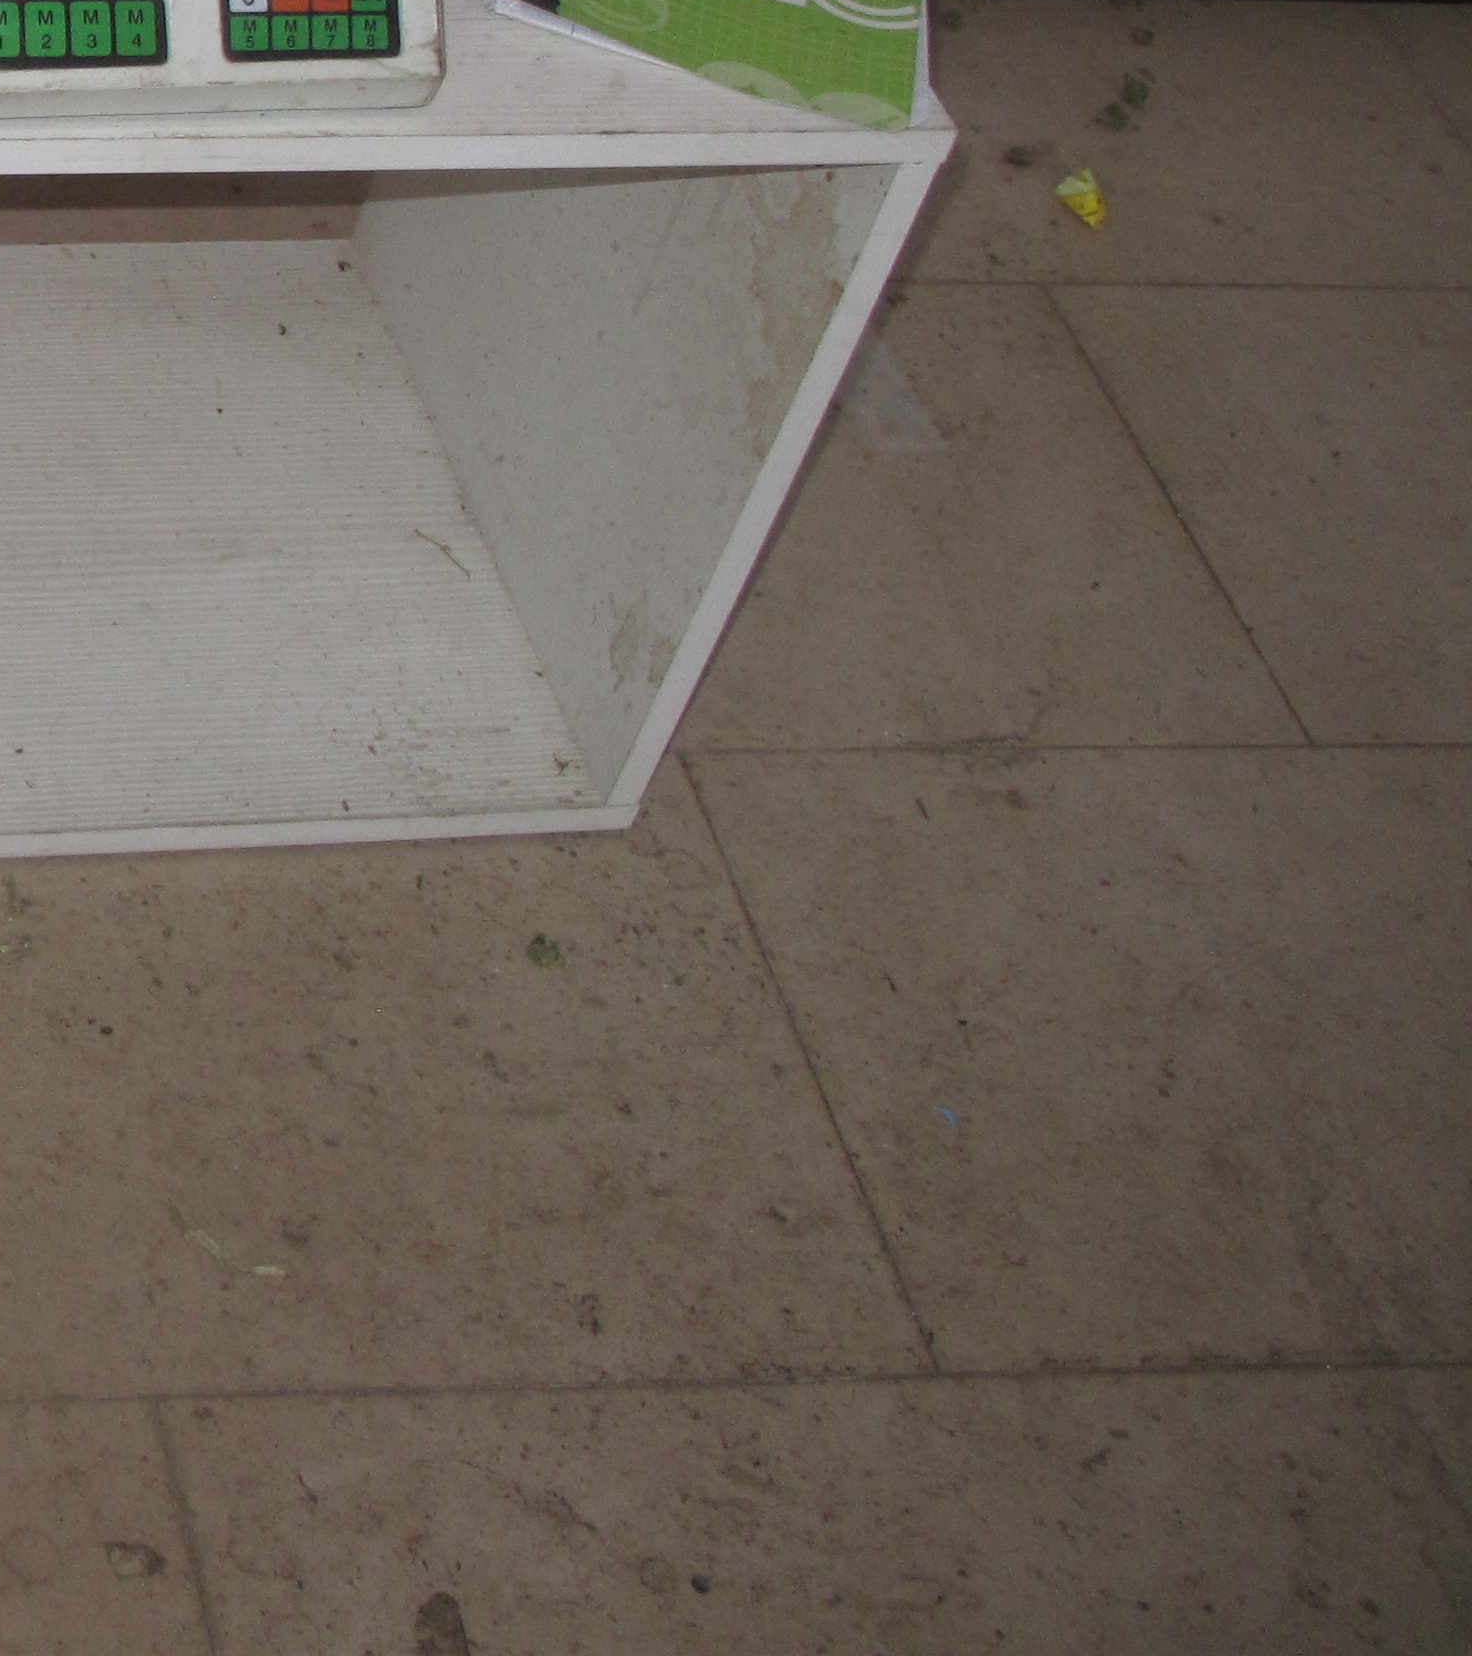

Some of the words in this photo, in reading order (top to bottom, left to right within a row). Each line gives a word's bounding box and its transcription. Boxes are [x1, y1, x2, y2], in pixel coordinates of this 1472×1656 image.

[37, 8, 54, 25] M
[82, 7, 99, 25] M
[127, 7, 144, 25] M
[242, 20, 256, 33] M
[284, 19, 298, 32] M
[324, 19, 338, 32] M
[364, 19, 377, 32] M
[40, 33, 52, 50] 2
[86, 32, 98, 50] 3
[130, 32, 143, 49] 4
[245, 34, 256, 49] 5
[286, 34, 297, 49] 6
[326, 34, 337, 48] 7
[366, 34, 376, 48] 8
